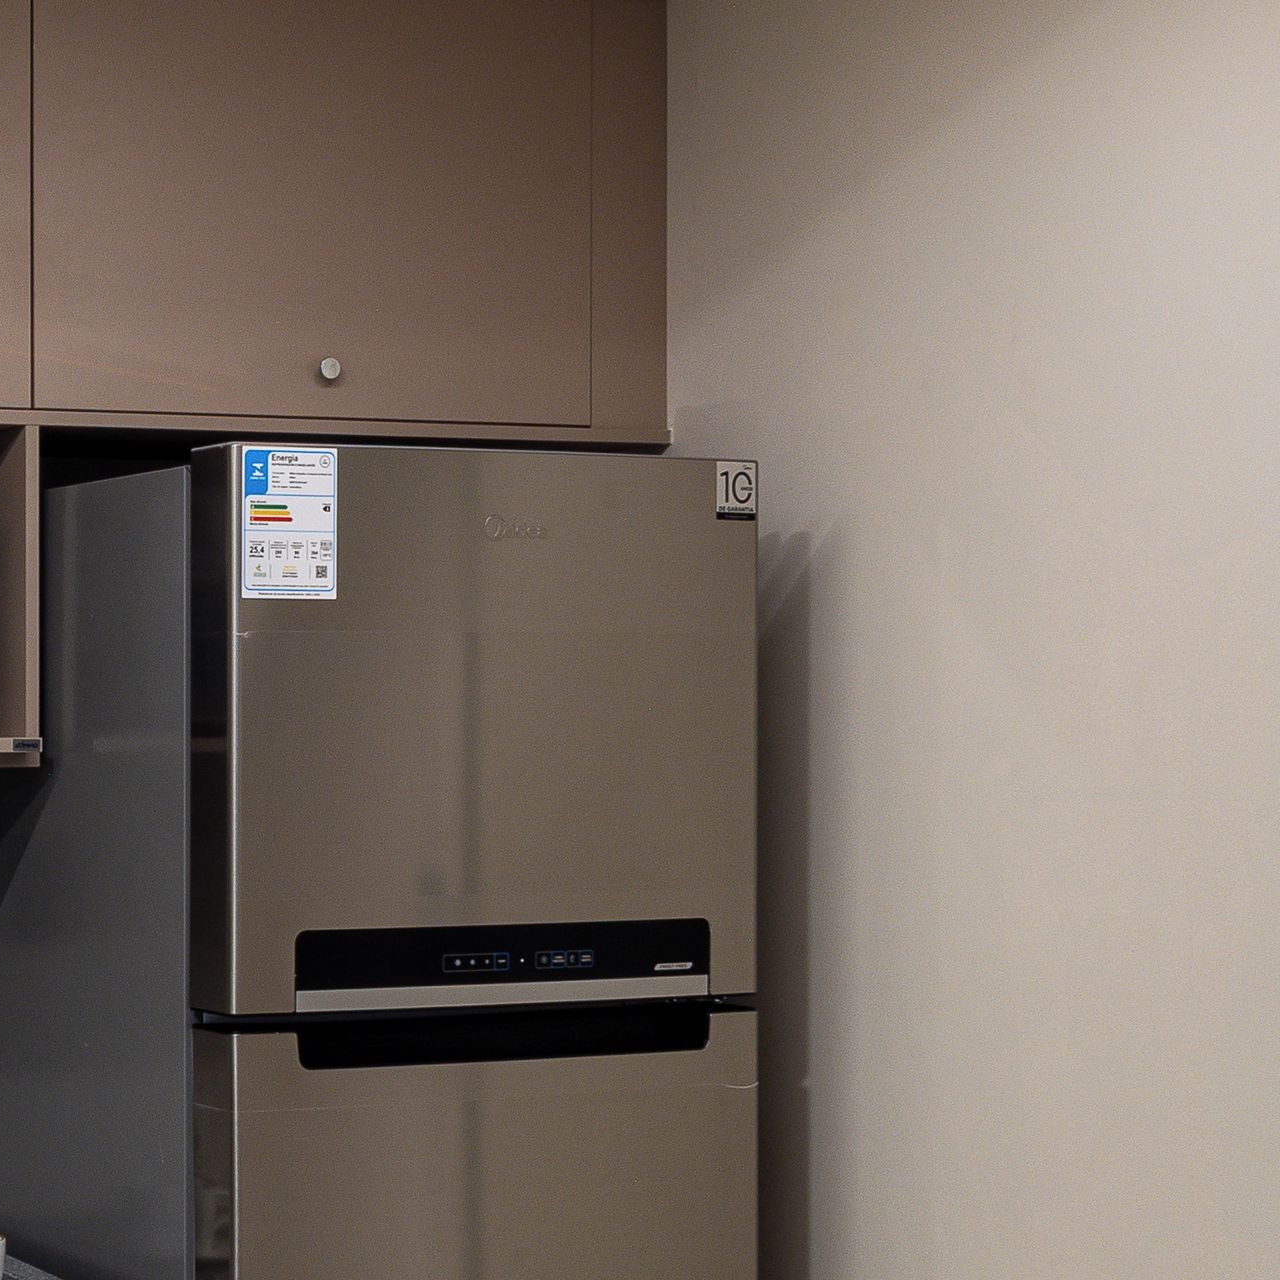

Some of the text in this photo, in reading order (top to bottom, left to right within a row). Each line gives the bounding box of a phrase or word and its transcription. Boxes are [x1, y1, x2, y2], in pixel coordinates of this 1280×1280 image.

[271, 453, 298, 463] Energia
[720, 470, 753, 504] 10
[249, 545, 265, 554] 25,4
